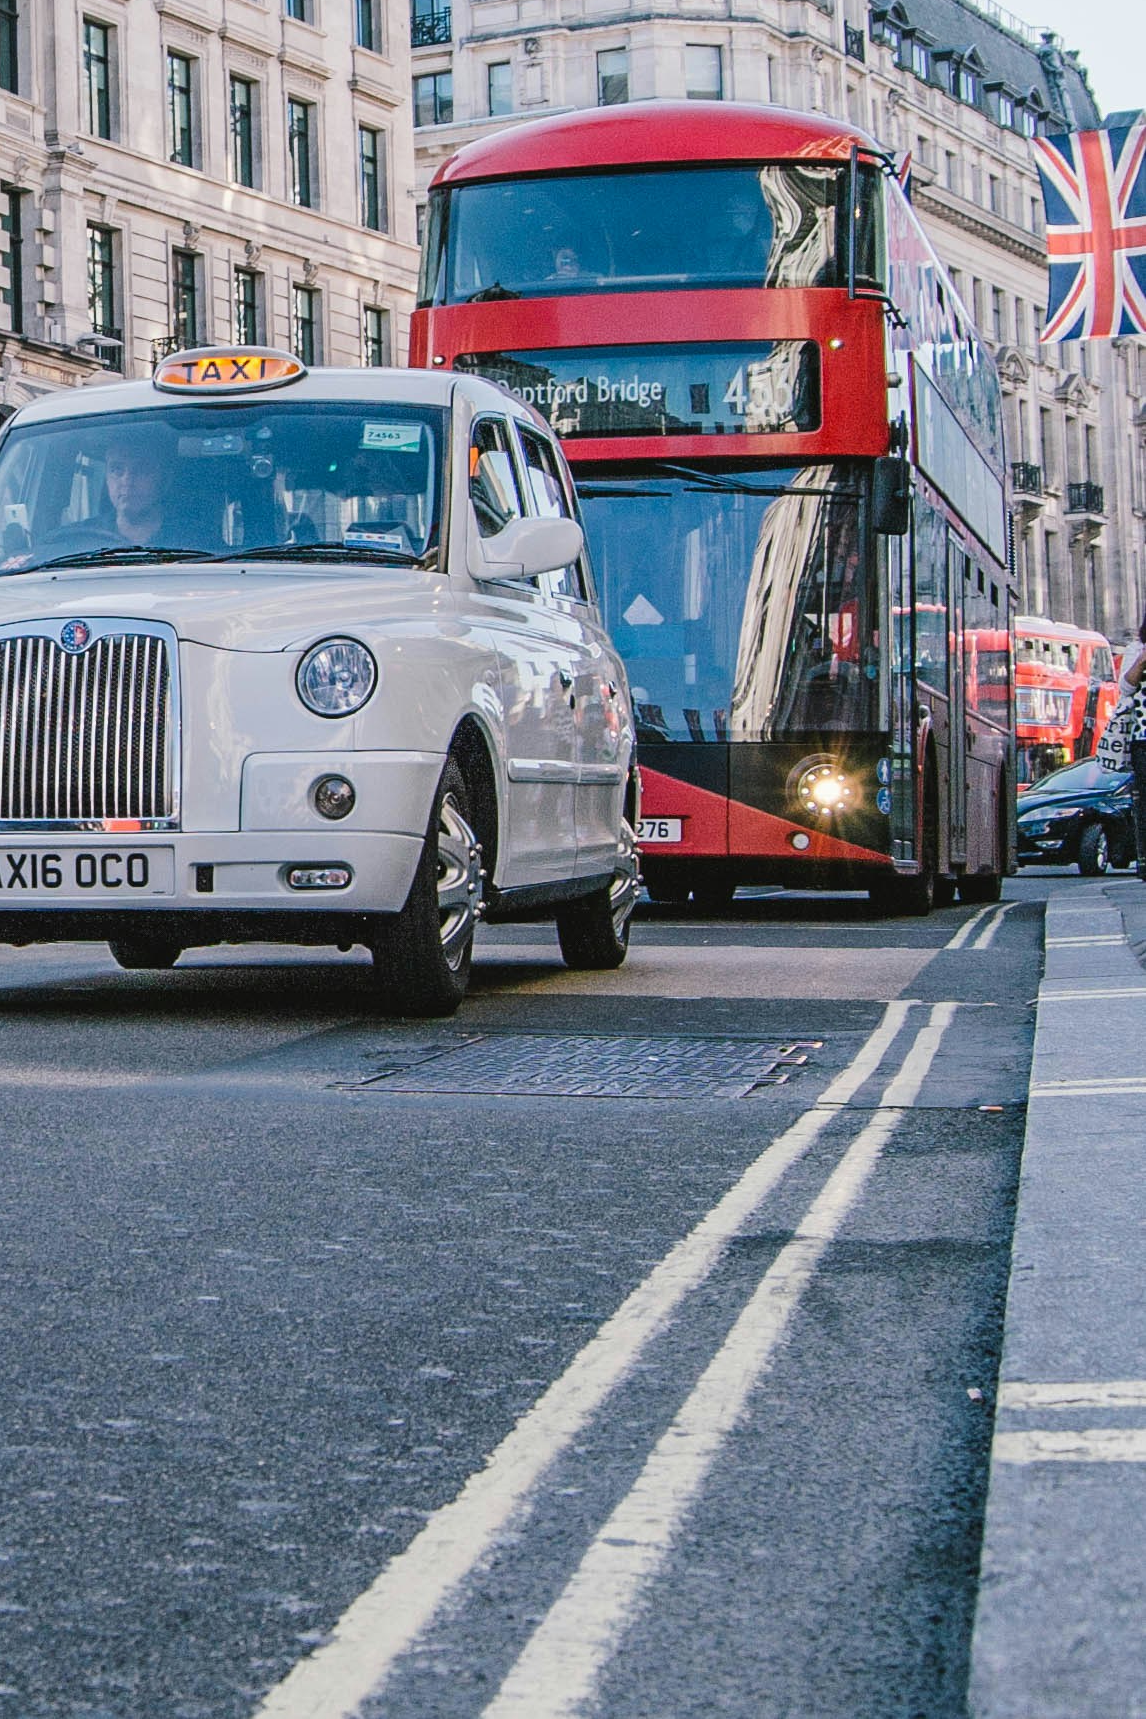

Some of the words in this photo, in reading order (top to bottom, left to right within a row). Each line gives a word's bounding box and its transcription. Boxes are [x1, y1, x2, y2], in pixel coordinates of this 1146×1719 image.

[181, 359, 266, 383] TAXI
[497, 377, 588, 405] ptford
[597, 375, 662, 407] Bridge
[75, 853, 149, 888] OCO
